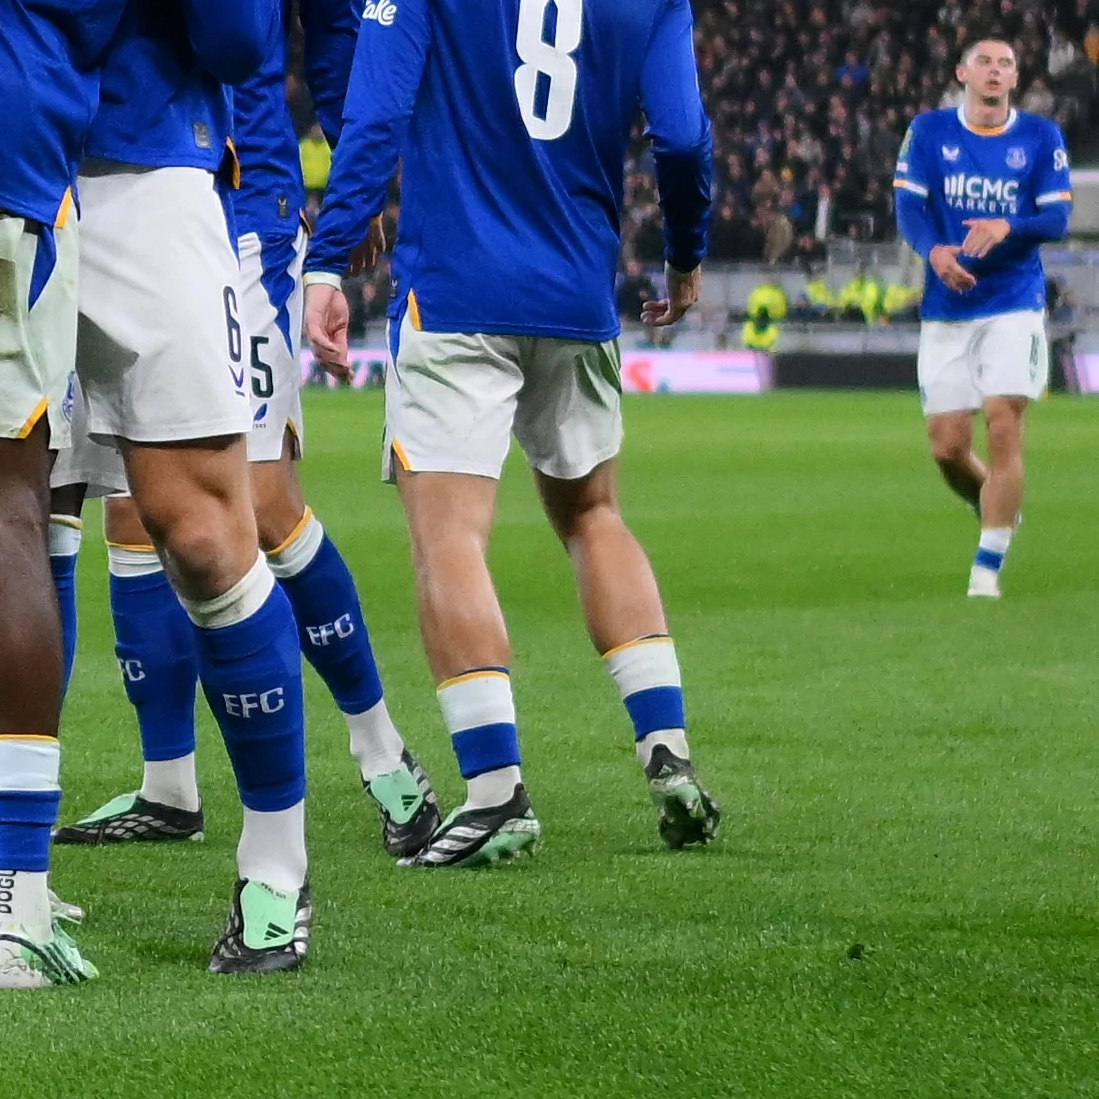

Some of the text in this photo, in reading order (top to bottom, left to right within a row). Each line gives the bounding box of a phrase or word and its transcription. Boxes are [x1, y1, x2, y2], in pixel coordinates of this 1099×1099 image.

[966, 177, 1019, 202] CMC
[222, 285, 243, 364] 6
[249, 334, 274, 399] 5
[306, 613, 354, 646] EFC
[223, 687, 284, 718] EFC
